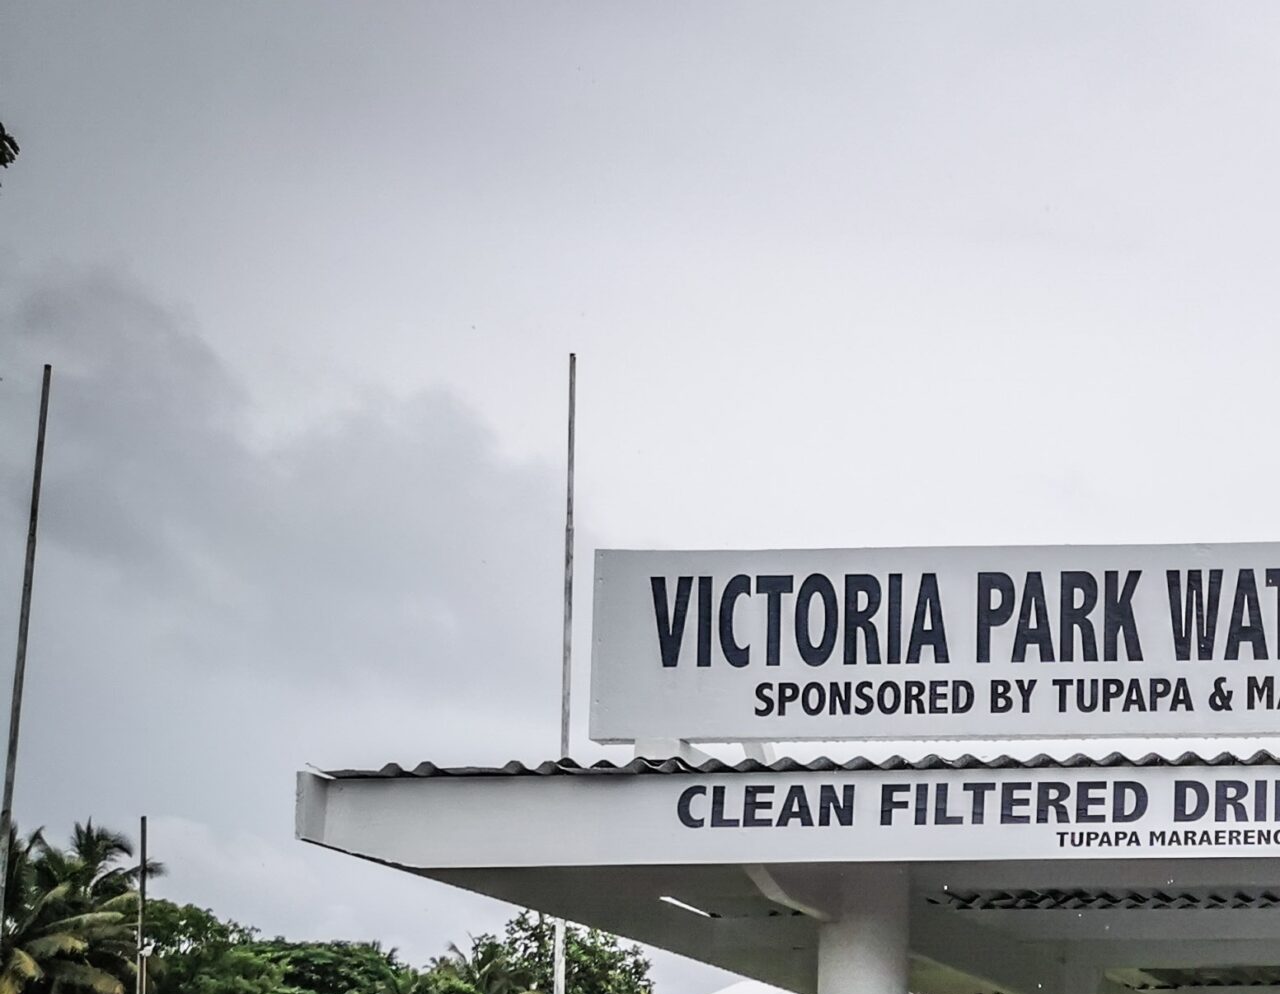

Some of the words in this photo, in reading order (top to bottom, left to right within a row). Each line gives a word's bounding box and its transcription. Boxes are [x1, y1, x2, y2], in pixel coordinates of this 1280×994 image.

[650, 573, 951, 668] VICTORIA
[977, 571, 1144, 663] PARK
[754, 679, 975, 717] SPONSORED
[990, 679, 1038, 714] BY
[1052, 678, 1194, 713] TUPAPA
[1208, 677, 1234, 712] &
[676, 784, 855, 829] CLEAN
[879, 781, 1149, 826] FILTERED
[1056, 831, 1141, 848] TUPAPA
